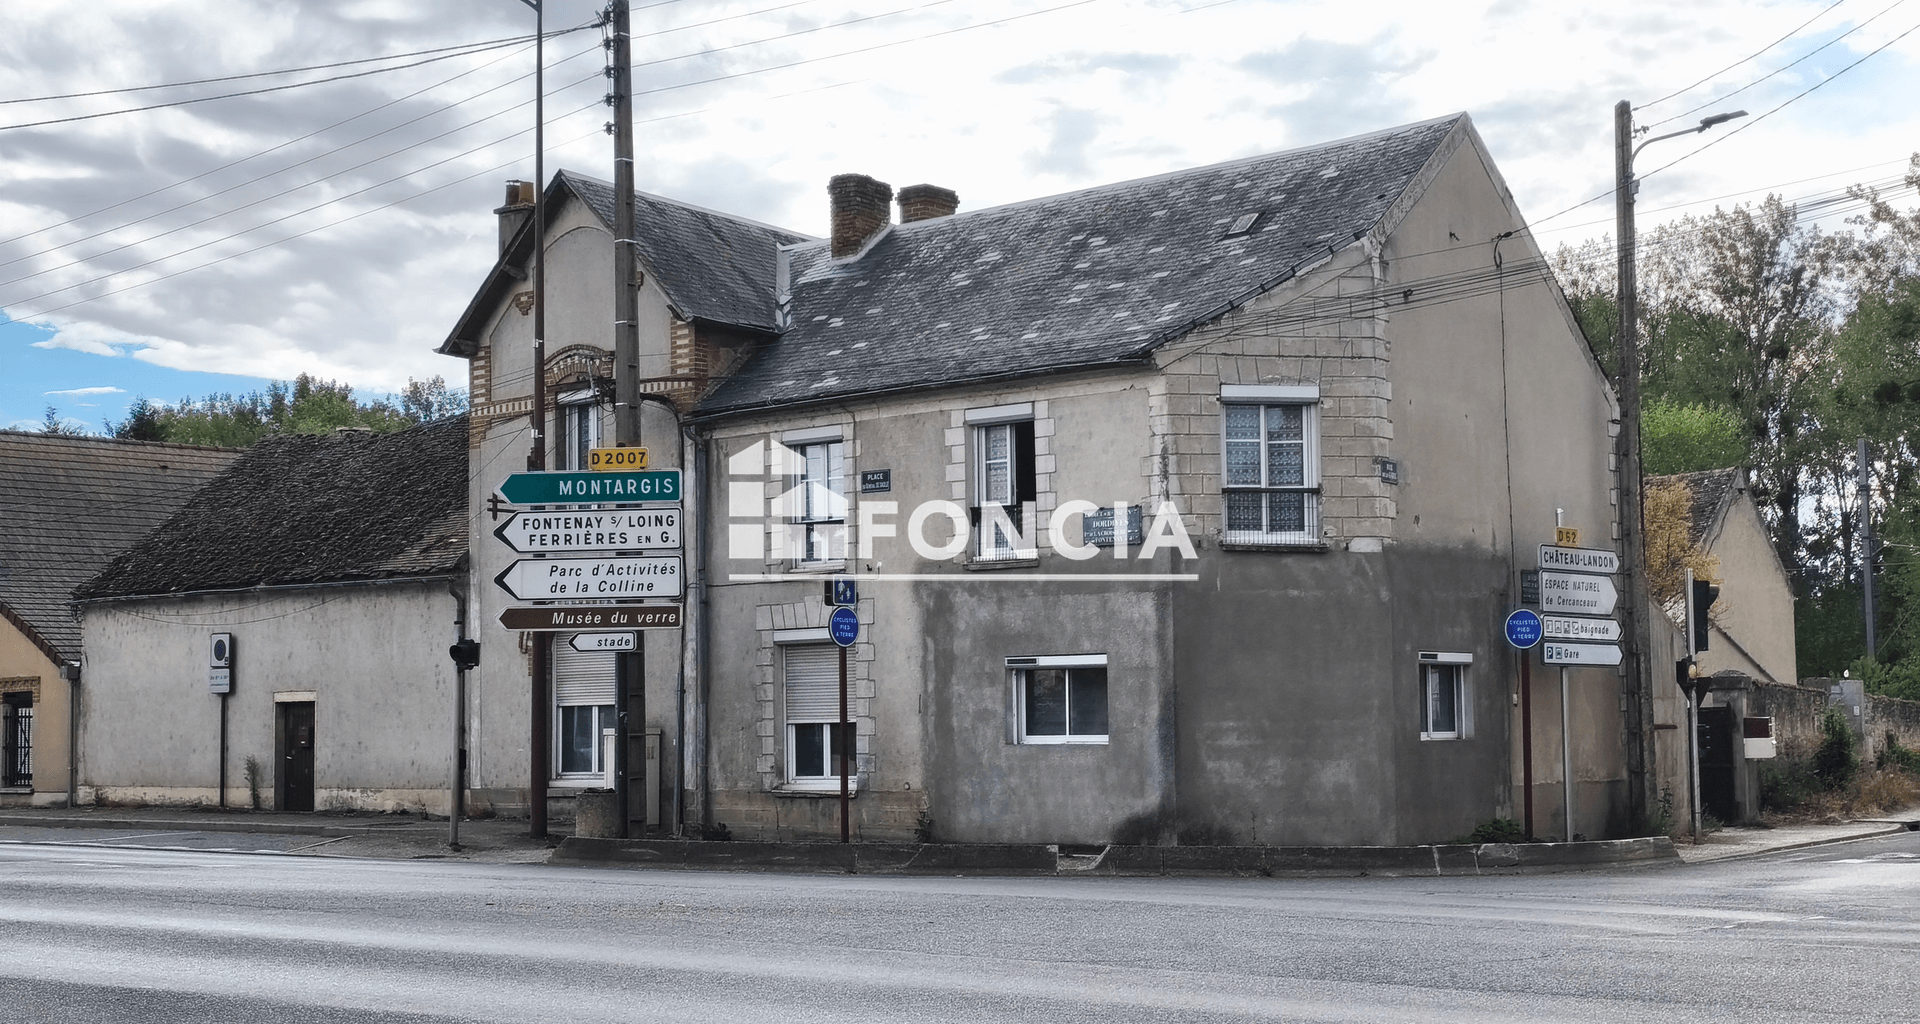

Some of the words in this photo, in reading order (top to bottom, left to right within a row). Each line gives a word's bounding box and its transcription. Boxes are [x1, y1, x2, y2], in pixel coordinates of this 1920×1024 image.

[592, 453, 600, 465] D
[604, 452, 646, 464] 2007
[559, 478, 674, 495] MONTARGIS
[522, 516, 603, 530] FONTENAY
[628, 515, 675, 527] LOING
[1092, 518, 1129, 528] DORDIVES
[529, 530, 628, 546] FERRIÈRES
[638, 536, 651, 544] EN
[661, 531, 676, 542] G.
[1558, 530, 1563, 542] D
[1566, 531, 1576, 543] 62
[1544, 550, 1614, 568] CHÂTEAU-LANDON
[550, 565, 582, 577] Parc
[592, 563, 676, 576] d'Activités
[550, 582, 567, 593] de
[576, 581, 589, 592] la
[598, 580, 654, 592] Colline
[1544, 579, 1568, 590] ESPACE
[1573, 581, 1600, 592] NATUREL
[1546, 595, 1553, 605] de
[1557, 596, 1597, 607] Cercanceaux
[552, 612, 601, 624] Musée
[611, 611, 628, 623] du
[637, 612, 676, 623] verre
[1581, 624, 1609, 636] baignade
[597, 637, 630, 647] stade
[1564, 649, 1579, 659] Gare
